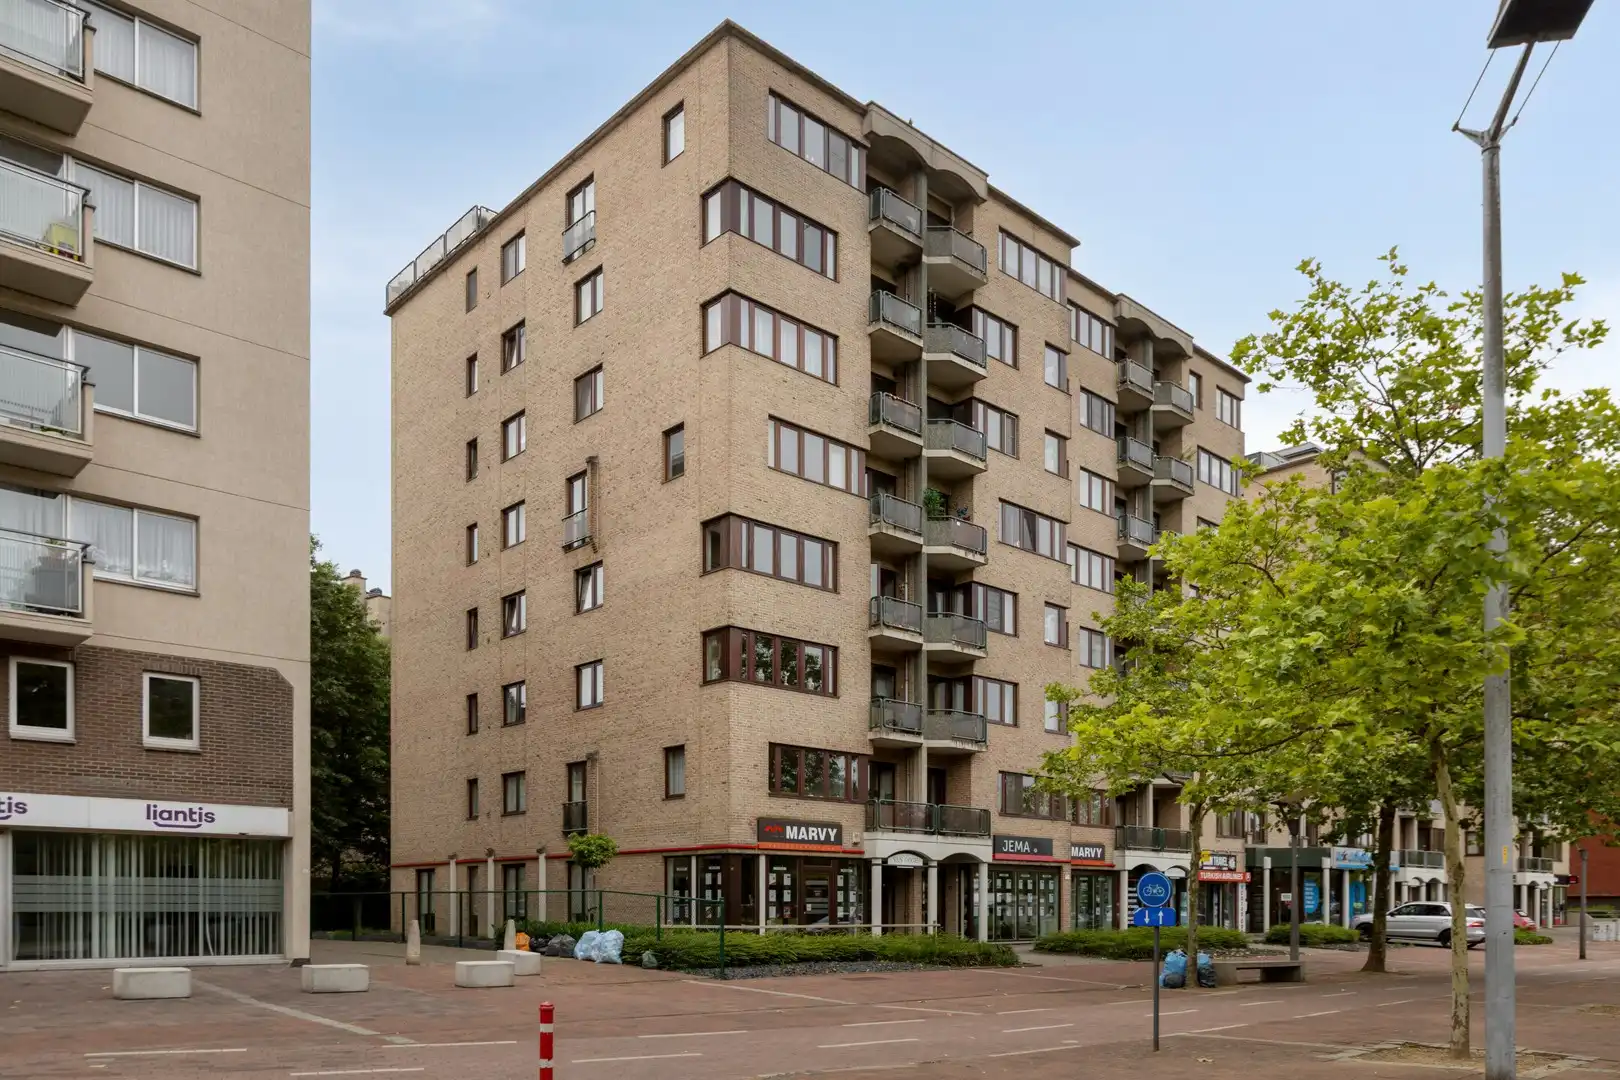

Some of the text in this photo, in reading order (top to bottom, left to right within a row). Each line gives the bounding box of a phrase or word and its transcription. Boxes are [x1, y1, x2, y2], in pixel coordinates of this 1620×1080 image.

[146, 804, 216, 823] liantis
[786, 826, 837, 841] MARVY
[1002, 840, 1030, 853] JEMA
[1071, 846, 1102, 858] MARVY
